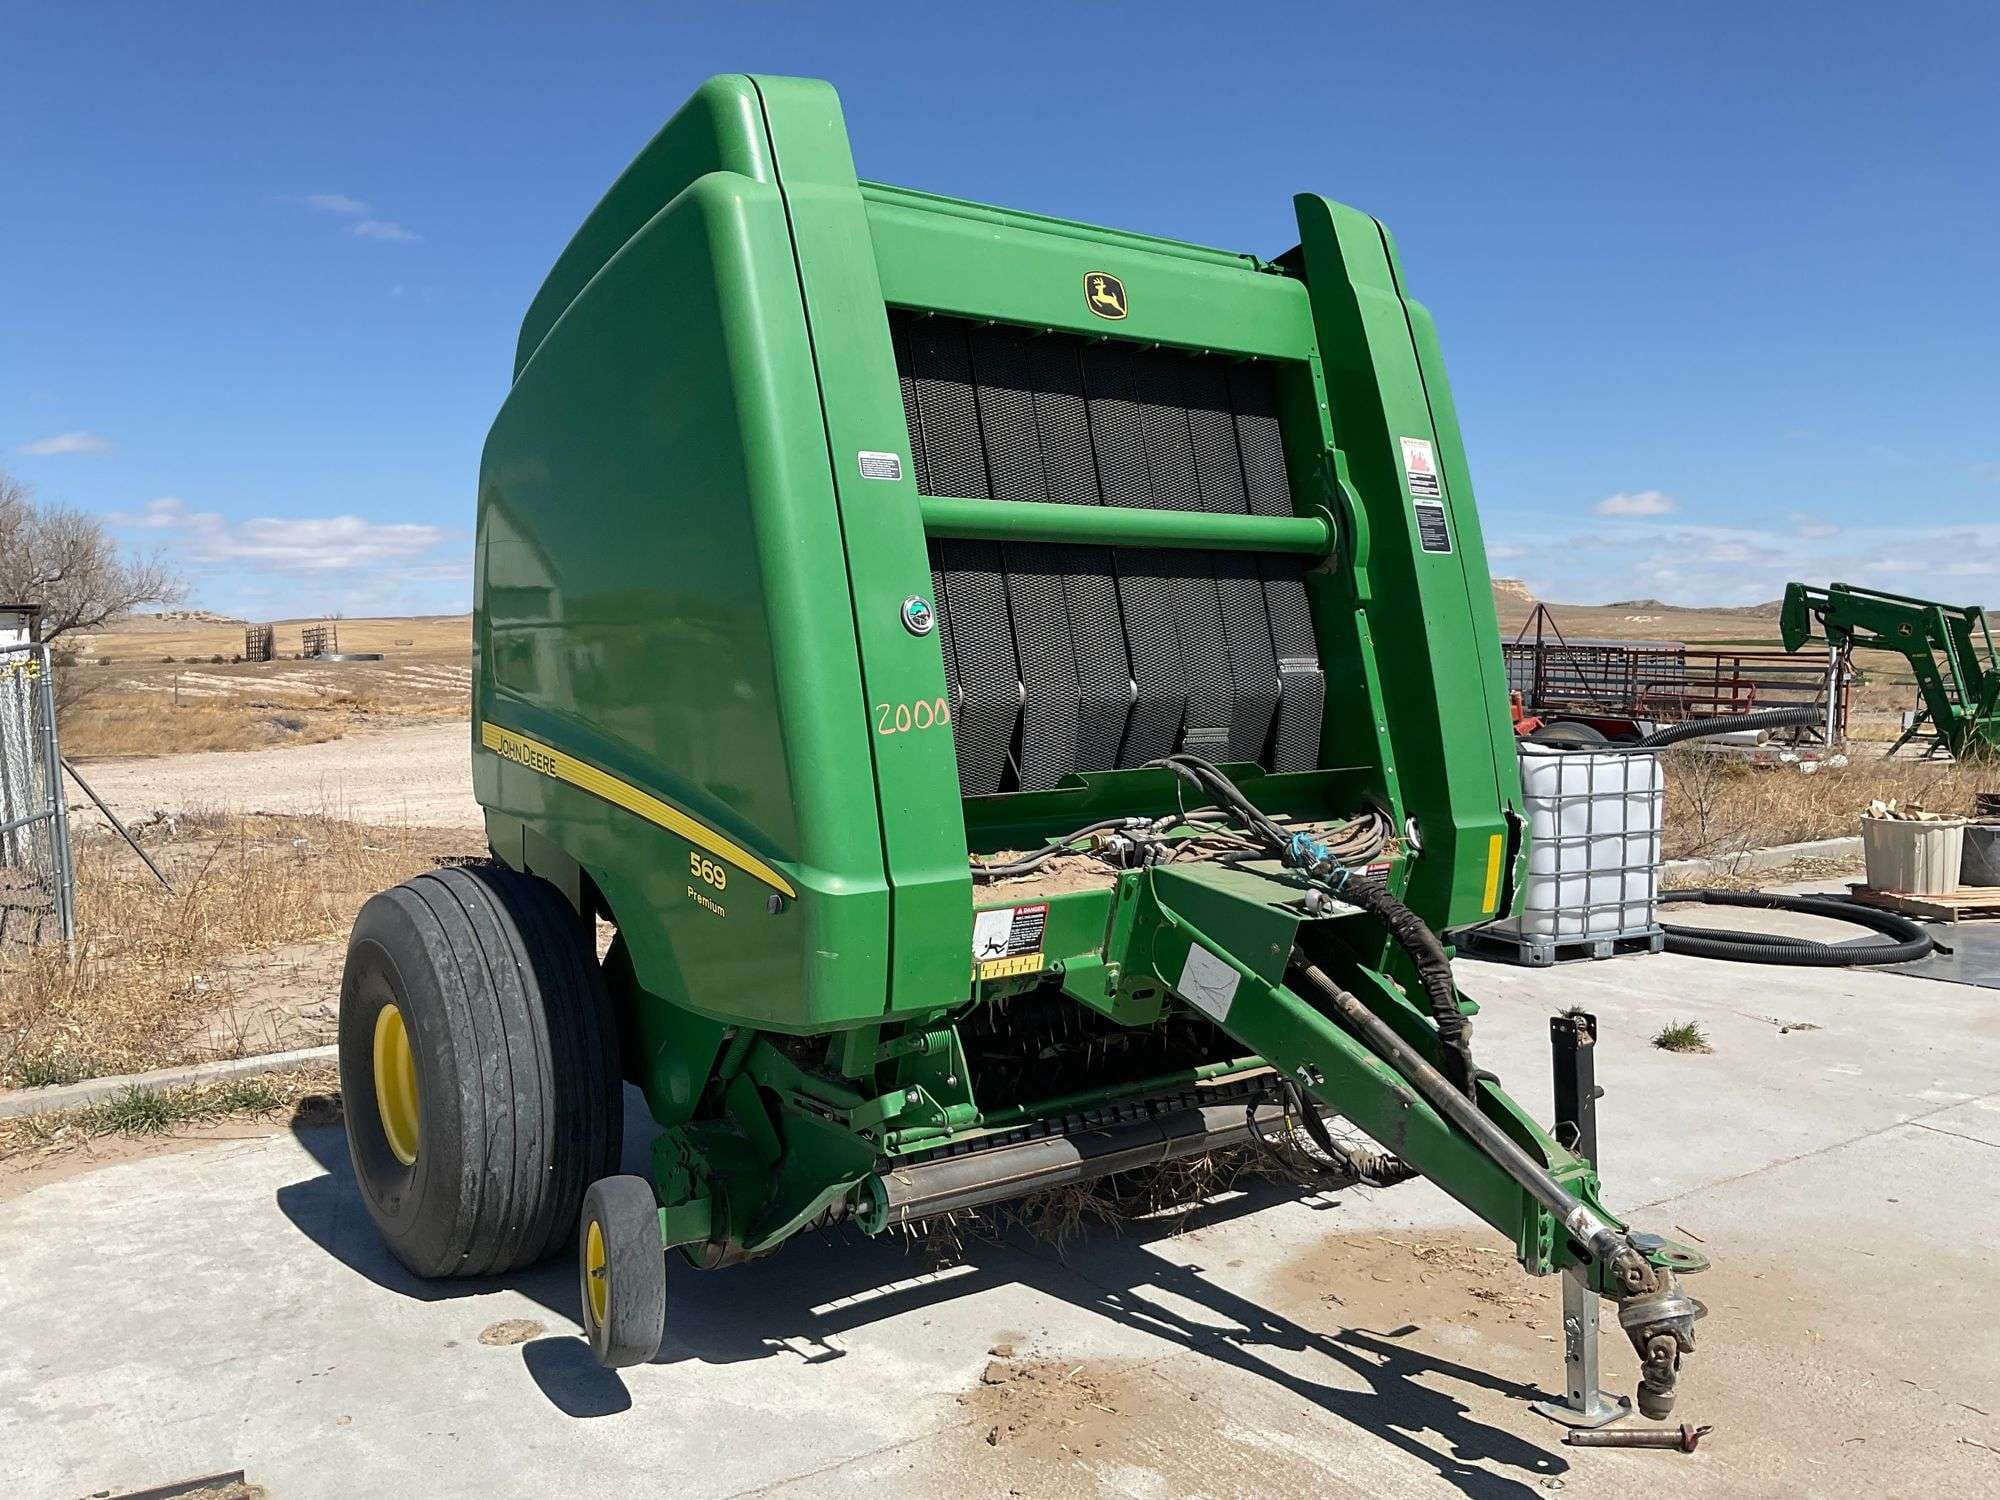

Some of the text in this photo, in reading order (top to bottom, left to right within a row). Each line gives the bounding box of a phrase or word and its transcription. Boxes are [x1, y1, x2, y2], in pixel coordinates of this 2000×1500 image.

[876, 698, 950, 735] 2000
[690, 851, 727, 890] 569
[687, 885, 725, 918] Premium
